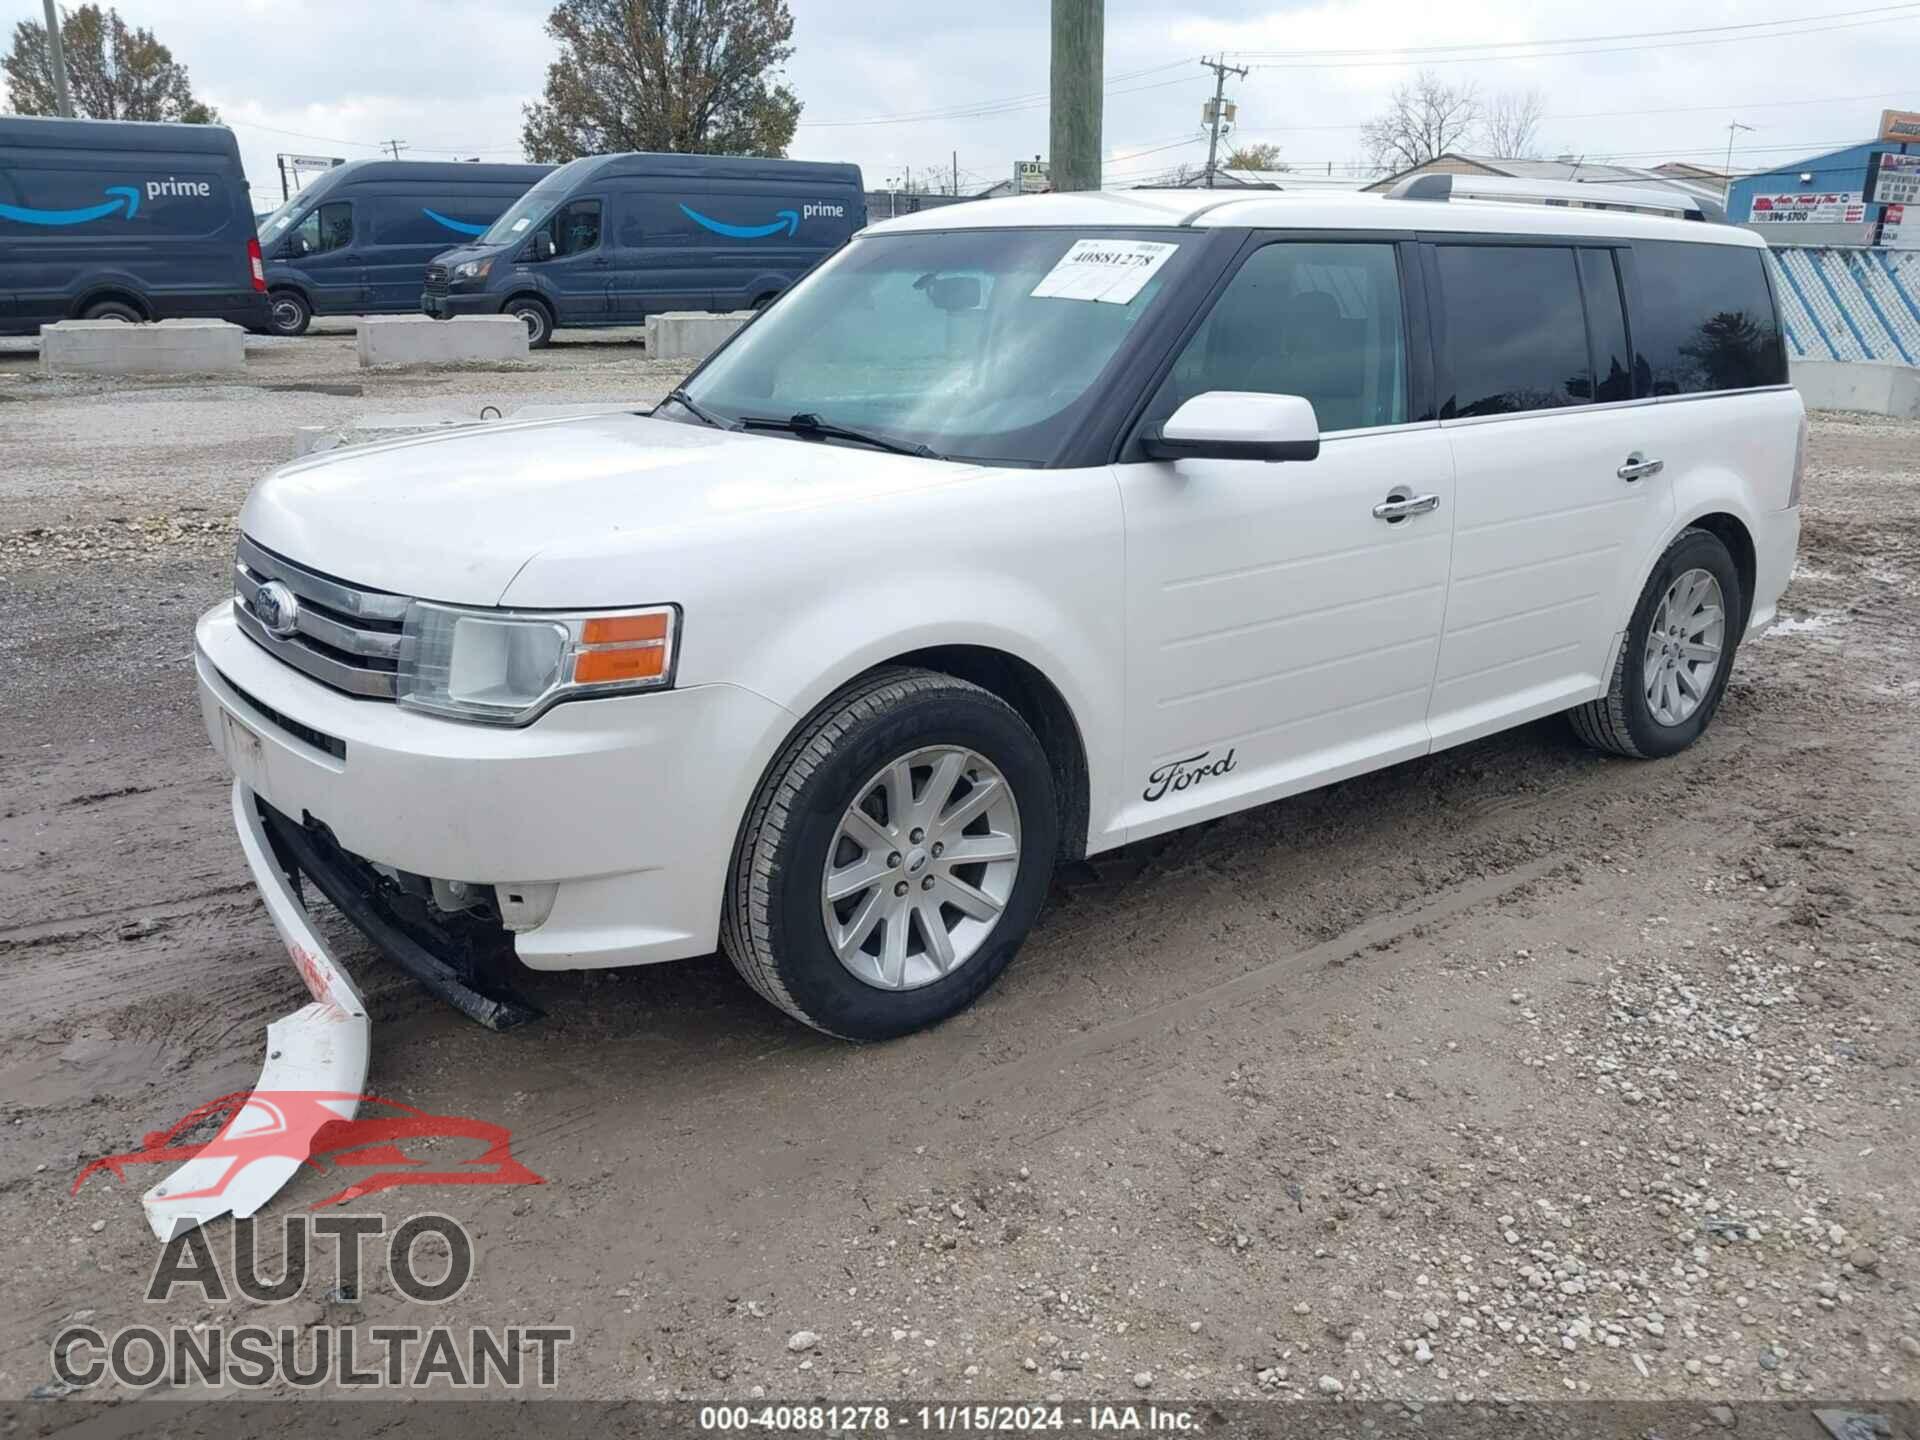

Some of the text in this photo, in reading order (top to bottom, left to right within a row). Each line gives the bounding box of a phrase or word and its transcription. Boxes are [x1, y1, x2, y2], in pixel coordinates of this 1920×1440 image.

[146, 176, 210, 200] prime
[803, 201, 844, 220] prime
[1072, 250, 1156, 266] 40881278
[1143, 748, 1238, 802] Ford
